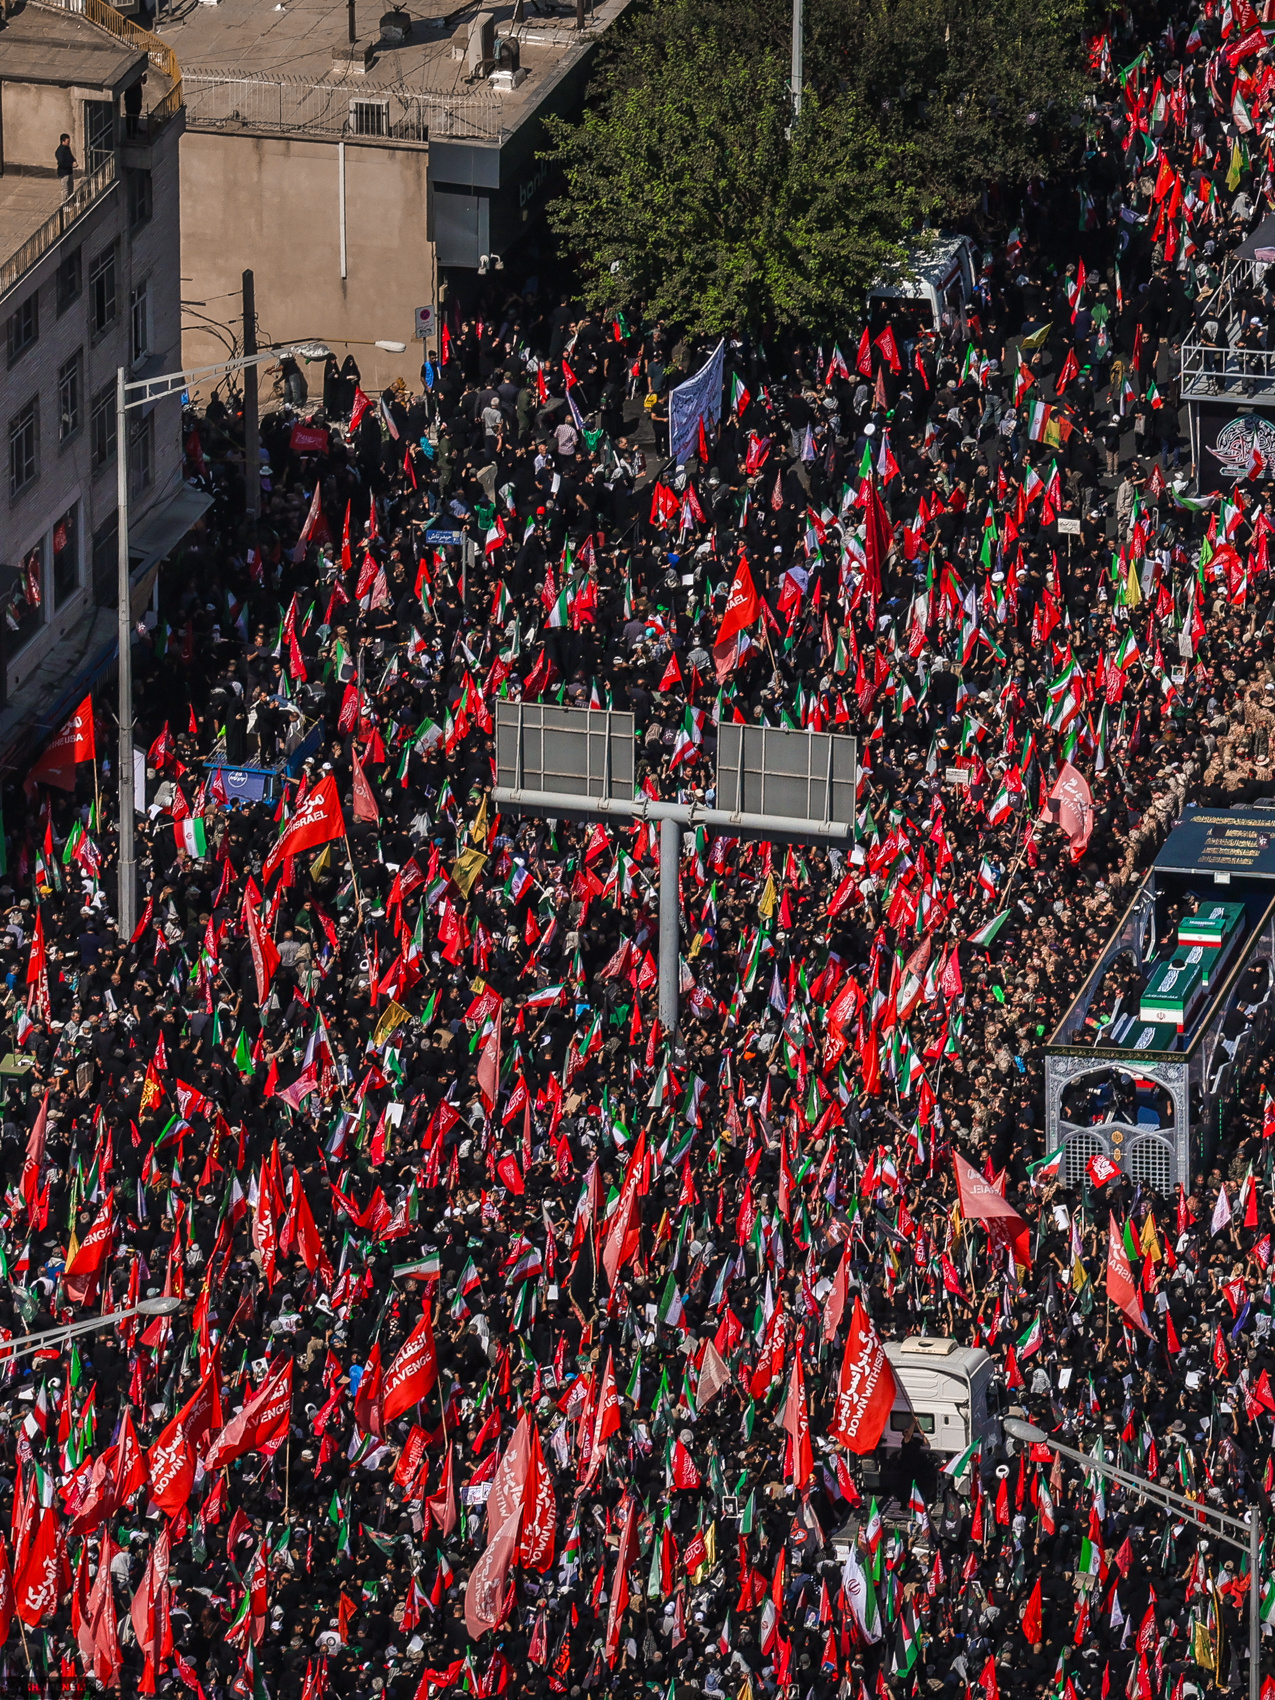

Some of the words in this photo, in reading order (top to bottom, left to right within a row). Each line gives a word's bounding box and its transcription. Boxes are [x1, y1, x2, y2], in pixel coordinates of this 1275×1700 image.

[64, 733, 84, 744] USA
[292, 810, 329, 832] ISRAEL
[392, 1350, 432, 1389] AVENGE
[847, 1397, 869, 1438] DOWN
[861, 1367, 881, 1398] WITH
[154, 1458, 186, 1495] DOWN
